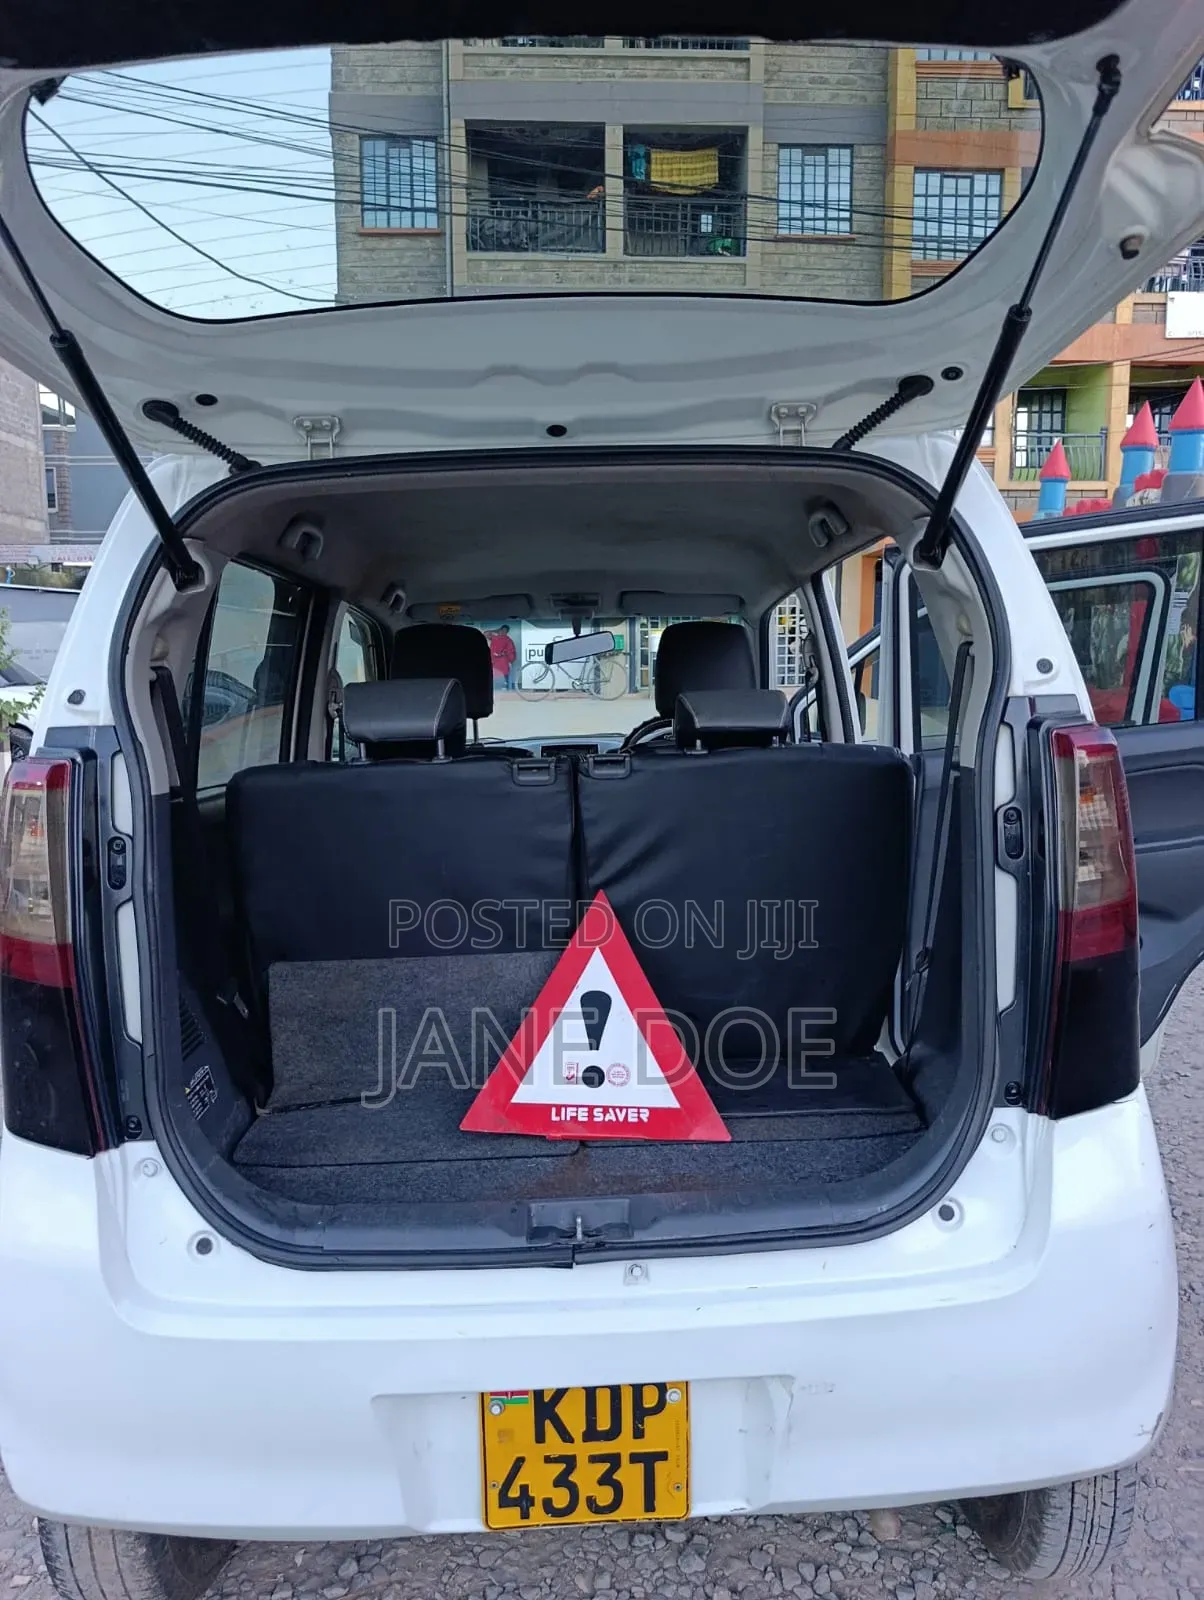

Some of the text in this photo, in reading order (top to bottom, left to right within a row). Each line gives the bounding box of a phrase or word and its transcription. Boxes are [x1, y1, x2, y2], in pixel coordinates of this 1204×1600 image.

[551, 1106, 650, 1123] LIFE SAVER
[533, 1383, 668, 1444] KDP
[498, 1451, 669, 1520] 433T
